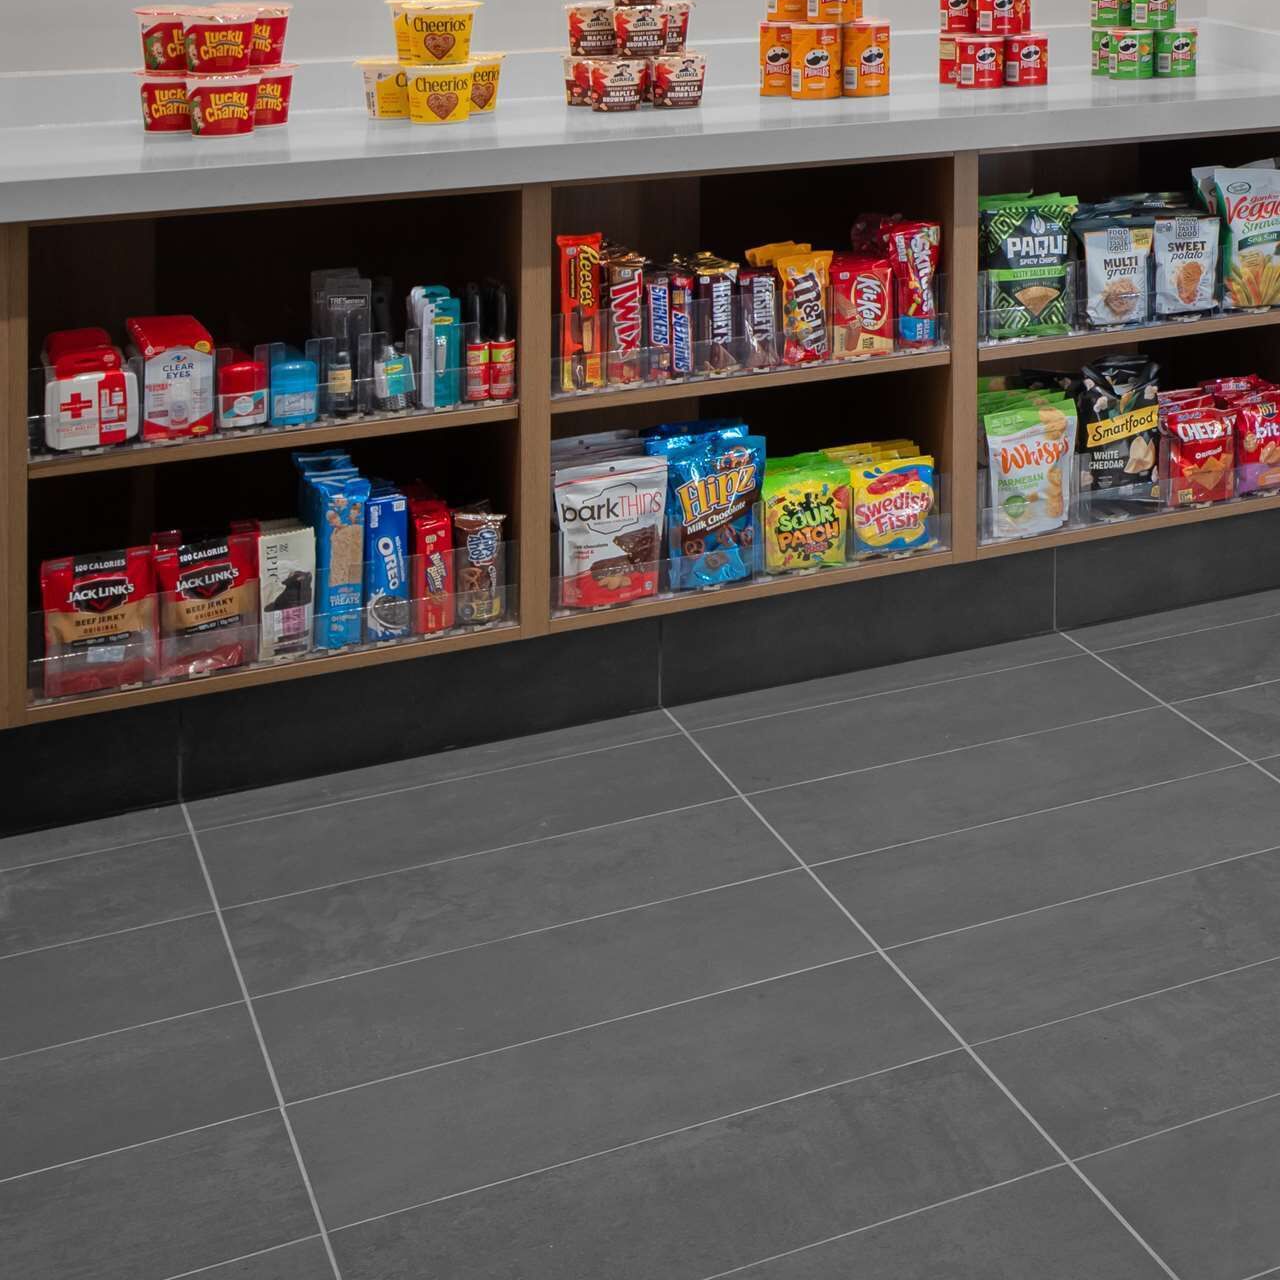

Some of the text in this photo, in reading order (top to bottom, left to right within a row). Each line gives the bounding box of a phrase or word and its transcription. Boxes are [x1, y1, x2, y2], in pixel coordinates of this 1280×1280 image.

[413, 17, 467, 33] Cheerios
[204, 30, 243, 46] Lucky
[200, 44, 244, 60] Charms
[415, 76, 469, 93] Cheerios
[155, 88, 186, 104] Luck
[209, 91, 249, 108] Lucky
[151, 102, 190, 119] Charm
[205, 106, 249, 122] Charms
[1167, 240, 1207, 253] SWEET
[1104, 255, 1139, 270] MULTI
[578, 244, 600, 307] Reese's
[1106, 267, 1138, 281] grain
[610, 269, 643, 361] TWIX
[713, 280, 733, 344] HERSHEY'S
[162, 362, 195, 372] CLEAR
[166, 371, 191, 380] EYES
[1092, 411, 1154, 443] Smartfood
[1093, 449, 1120, 460] WHITE
[1088, 459, 1125, 471] CHEDDAR
[854, 491, 933, 527] Swedish
[777, 503, 835, 533] SOUR
[874, 511, 921, 537] Fish
[775, 519, 841, 553] PATCH
[377, 536, 399, 590] OREO
[176, 568, 240, 592] JACK LINK'S
[68, 583, 135, 604] JACK LINK'S
